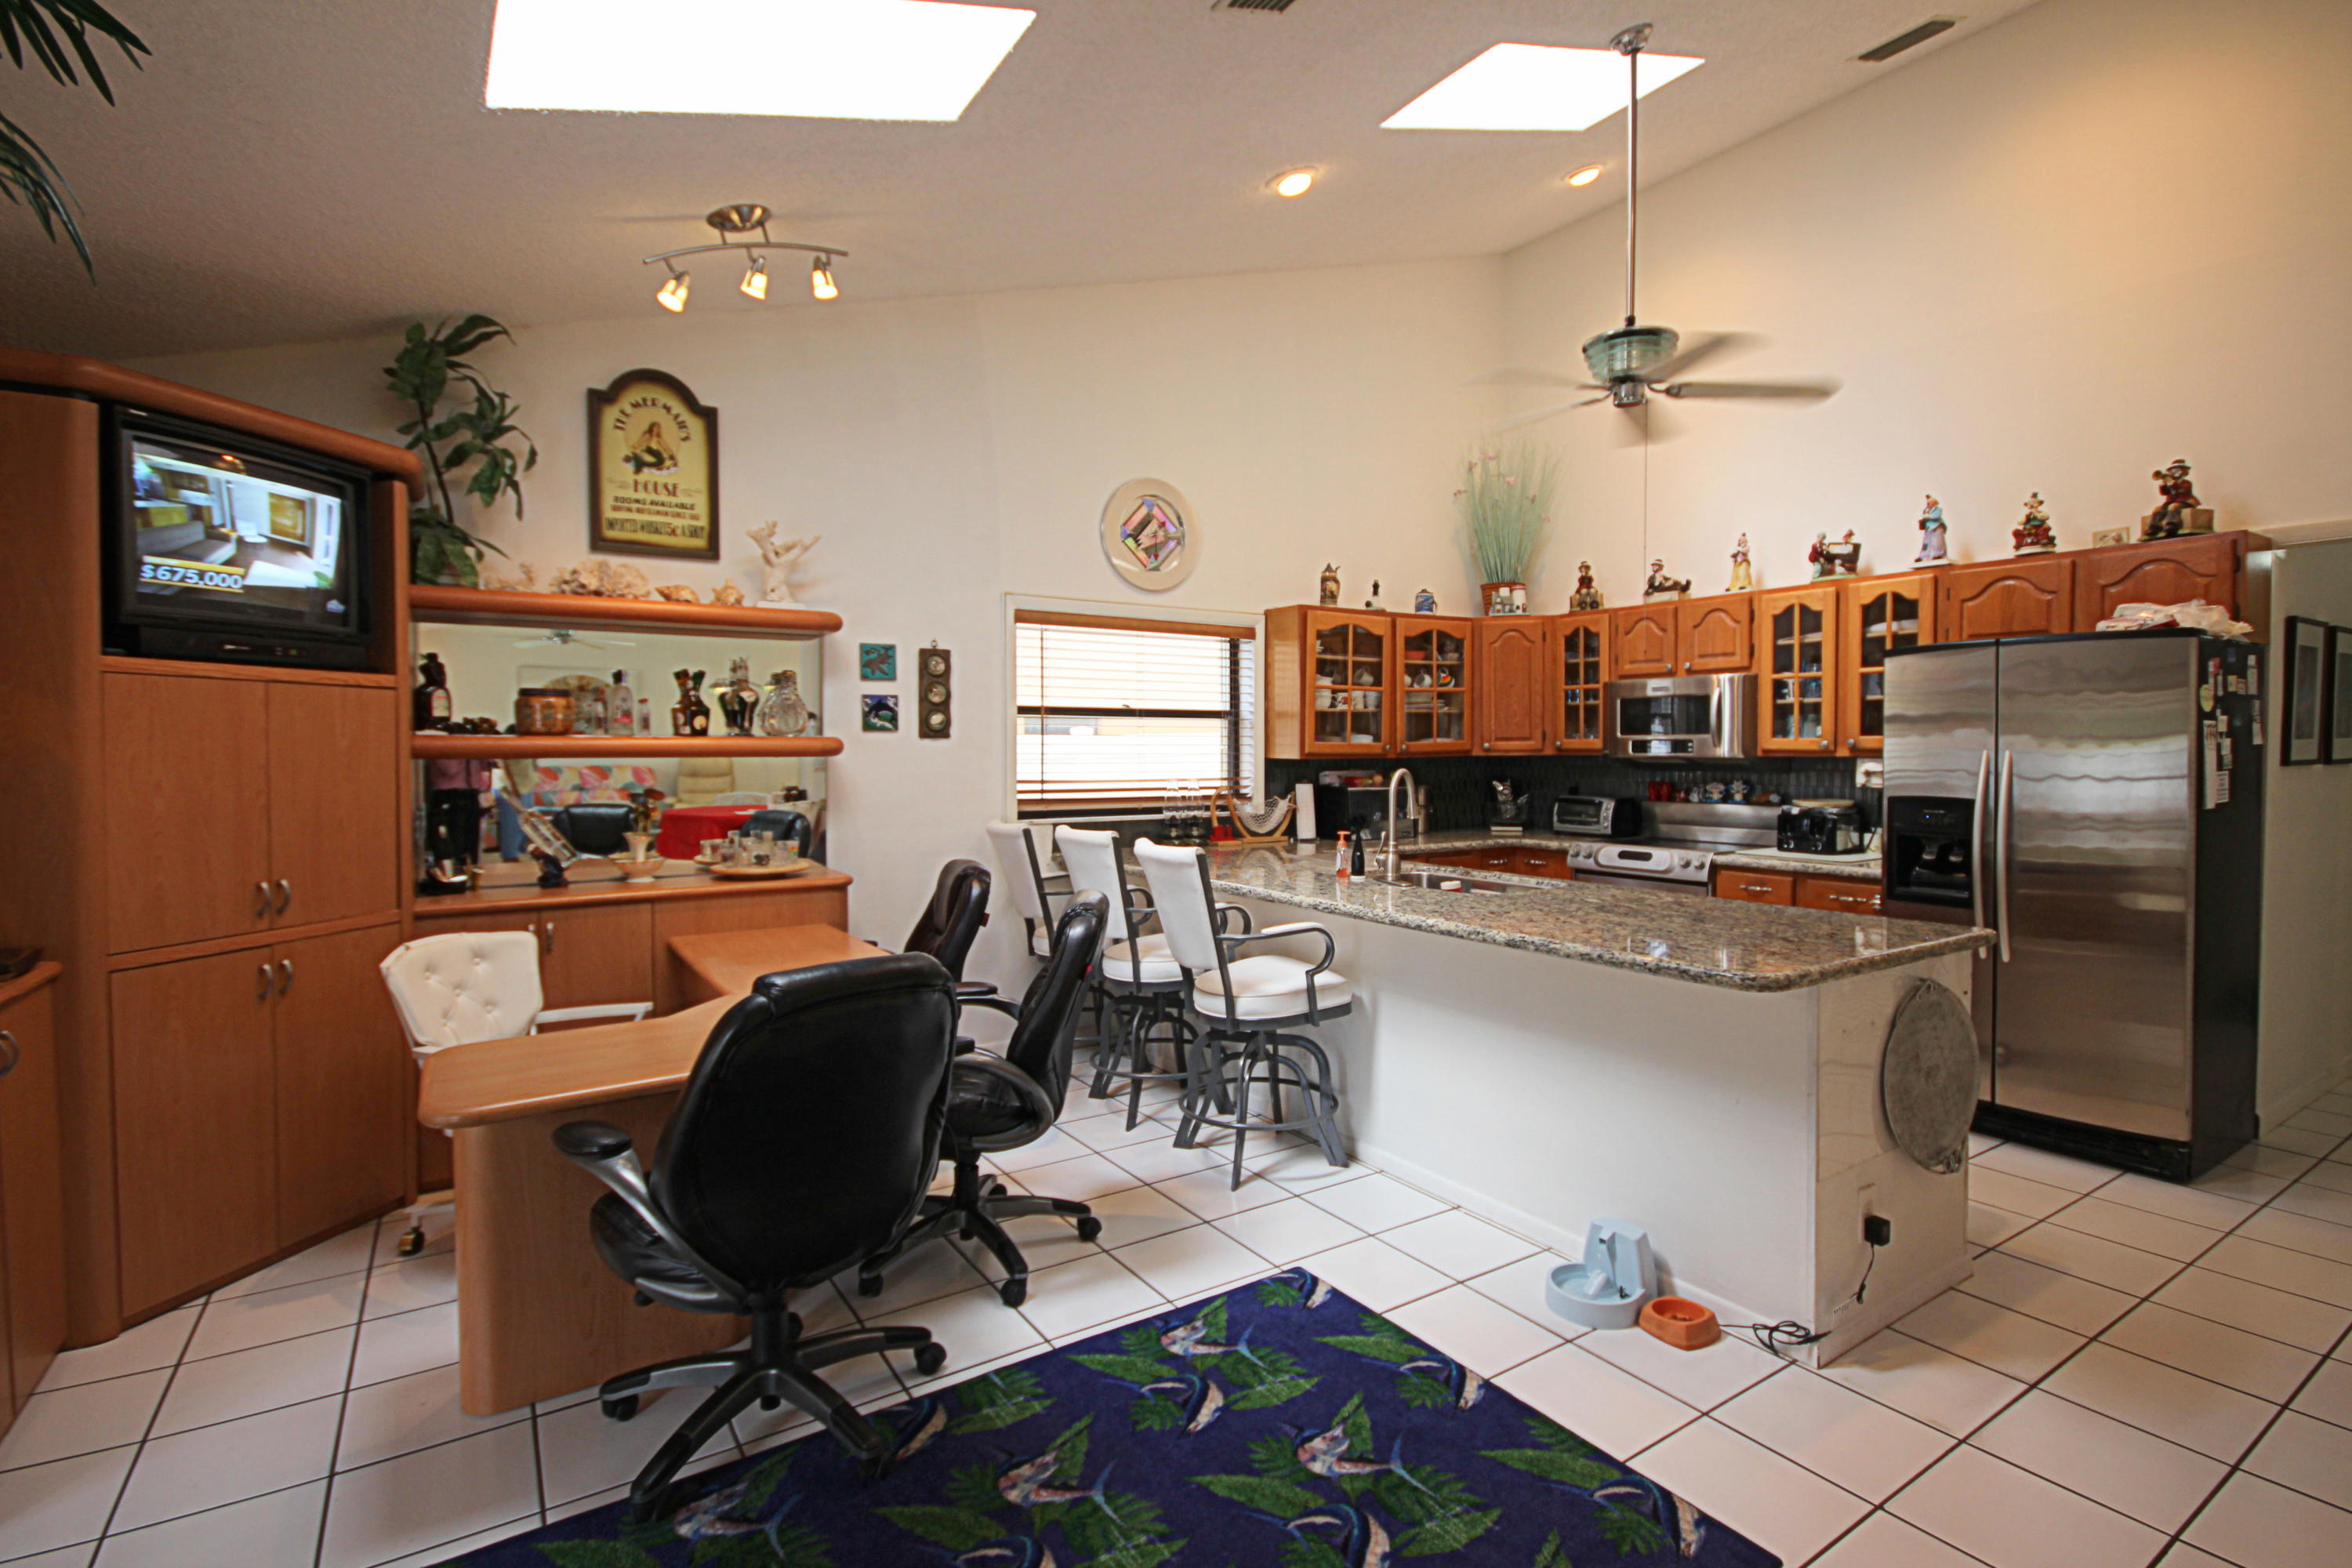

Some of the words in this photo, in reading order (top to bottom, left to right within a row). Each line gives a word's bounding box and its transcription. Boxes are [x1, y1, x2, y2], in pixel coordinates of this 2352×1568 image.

[633, 478, 679, 498] HOUSE
[613, 495, 647, 506] ROOMS
[648, 499, 696, 510] AVAILABLE
[140, 564, 243, 589] $675,000
